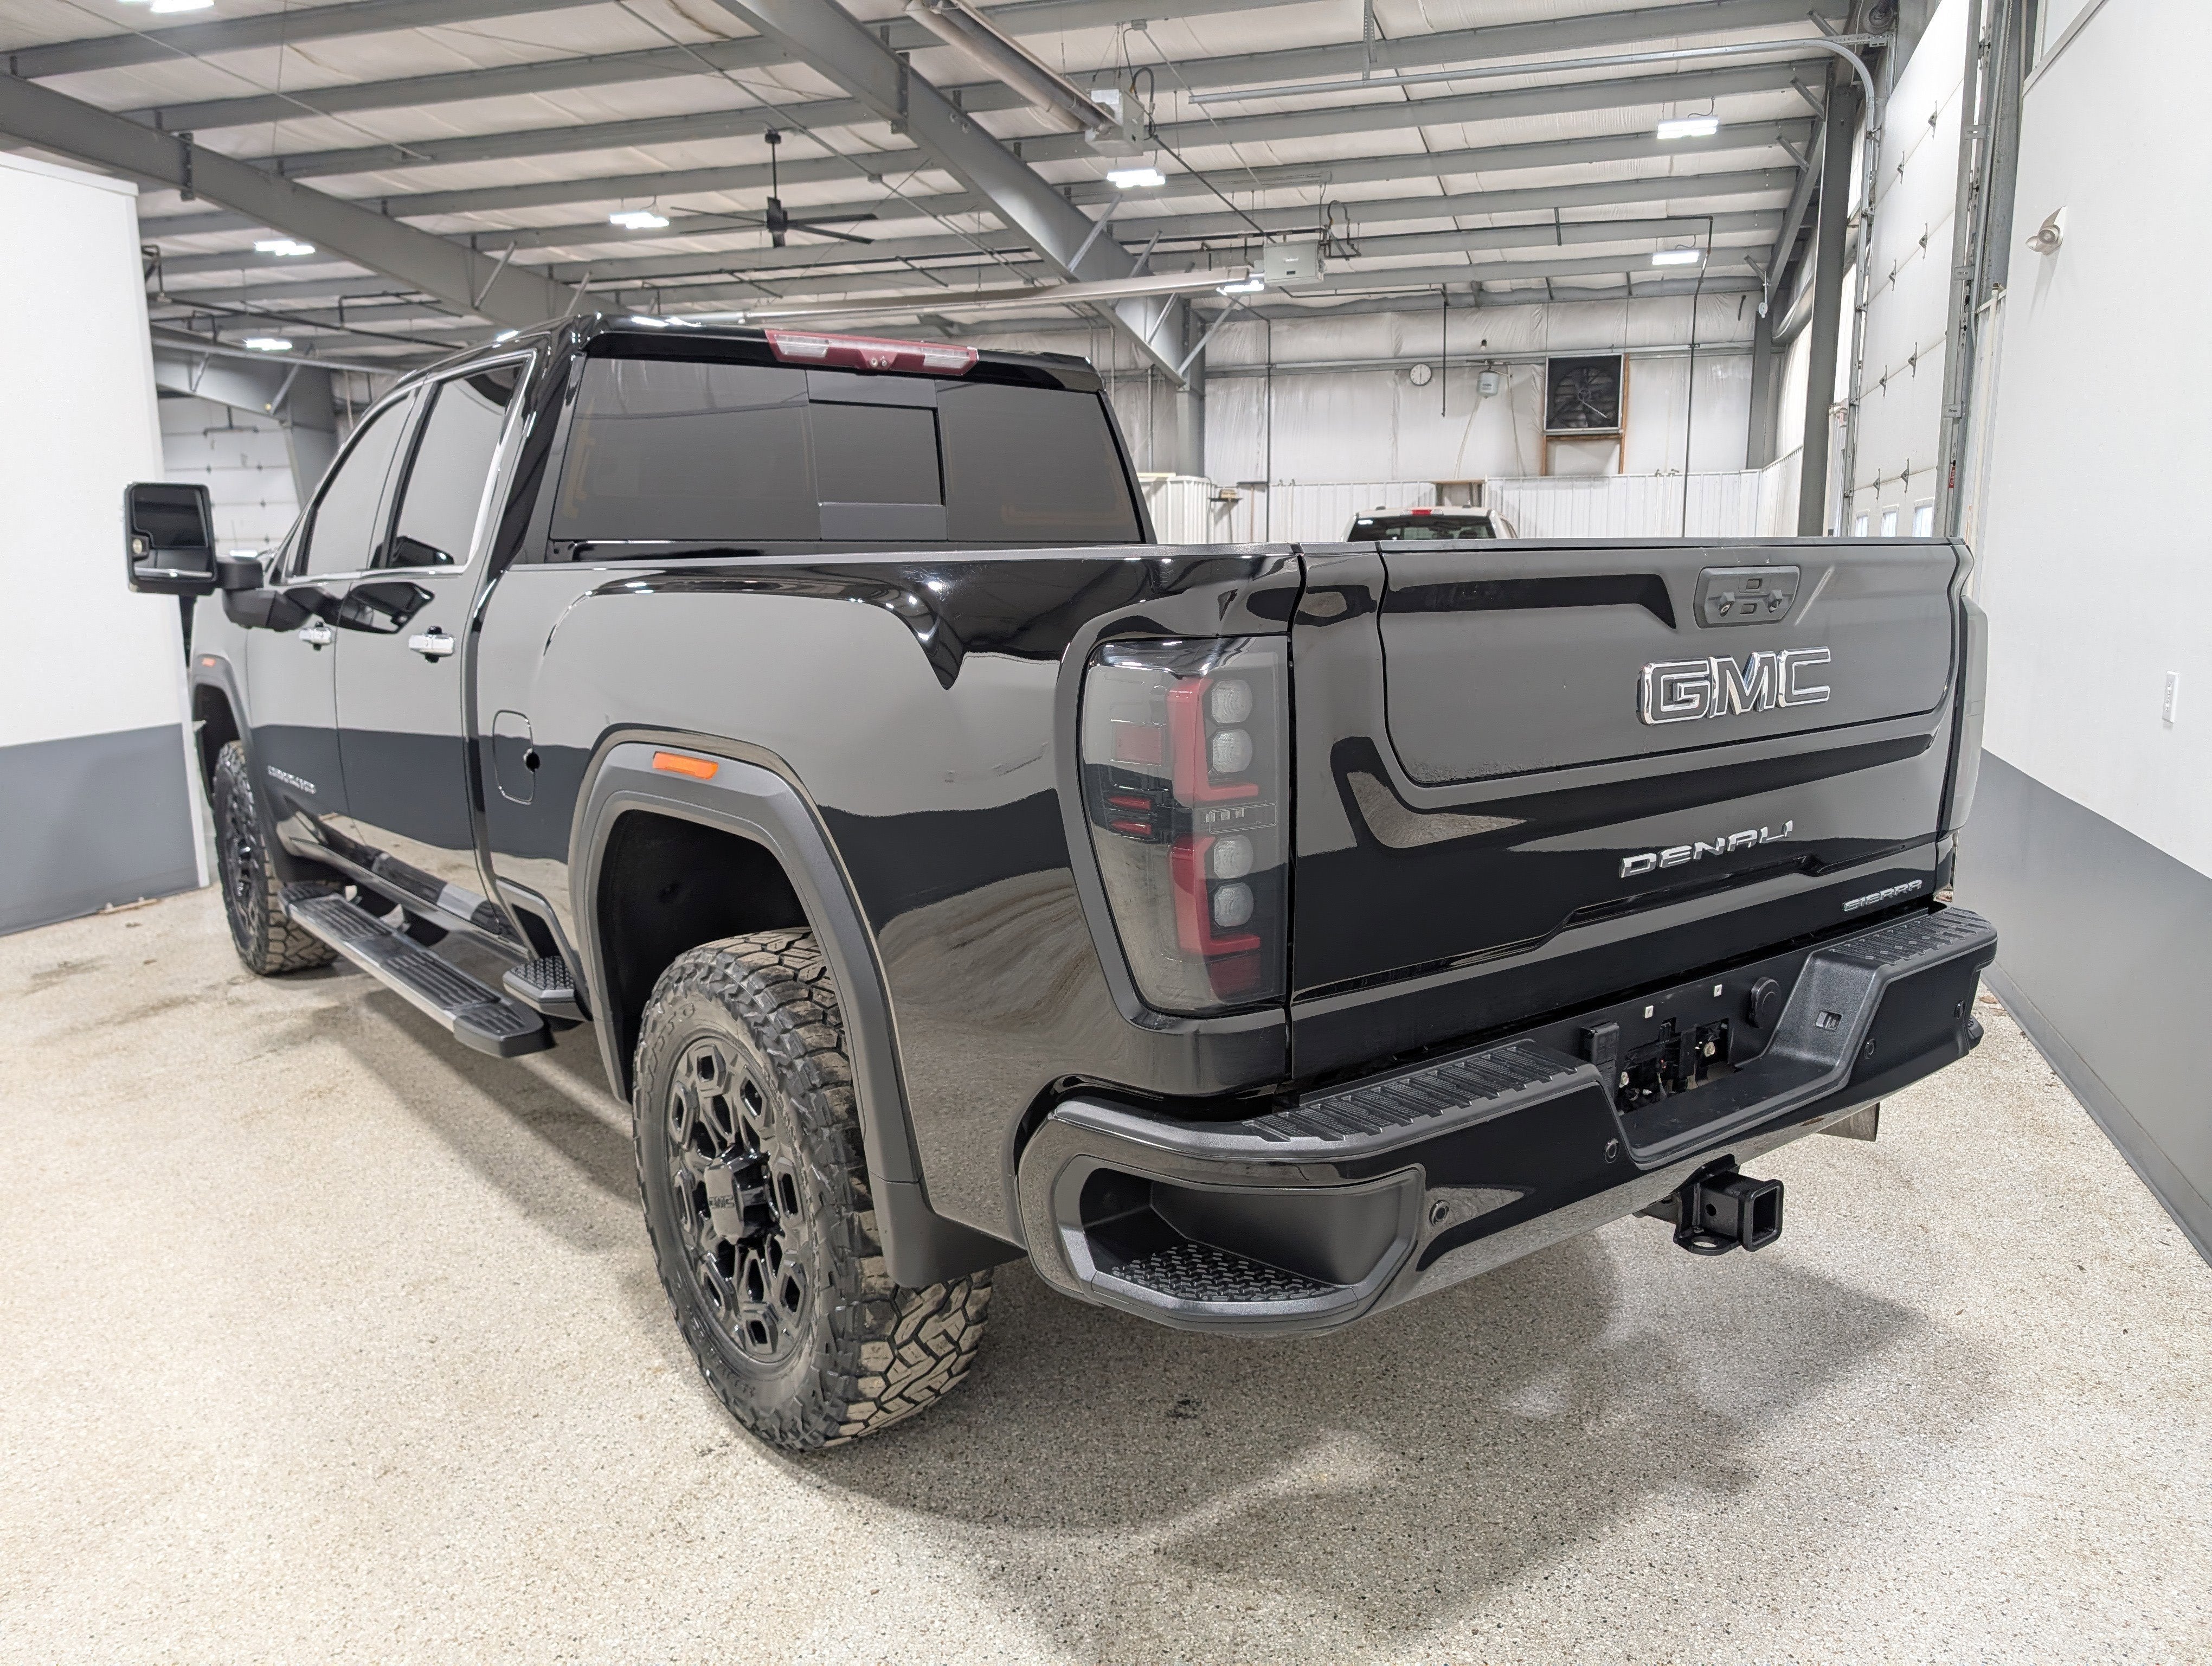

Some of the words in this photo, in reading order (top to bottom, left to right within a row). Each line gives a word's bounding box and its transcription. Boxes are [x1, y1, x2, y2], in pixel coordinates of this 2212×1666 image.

[1637, 646, 1831, 726] GMC
[1619, 820, 1793, 879] DENALI
[1842, 879, 1922, 912] SIERRA
